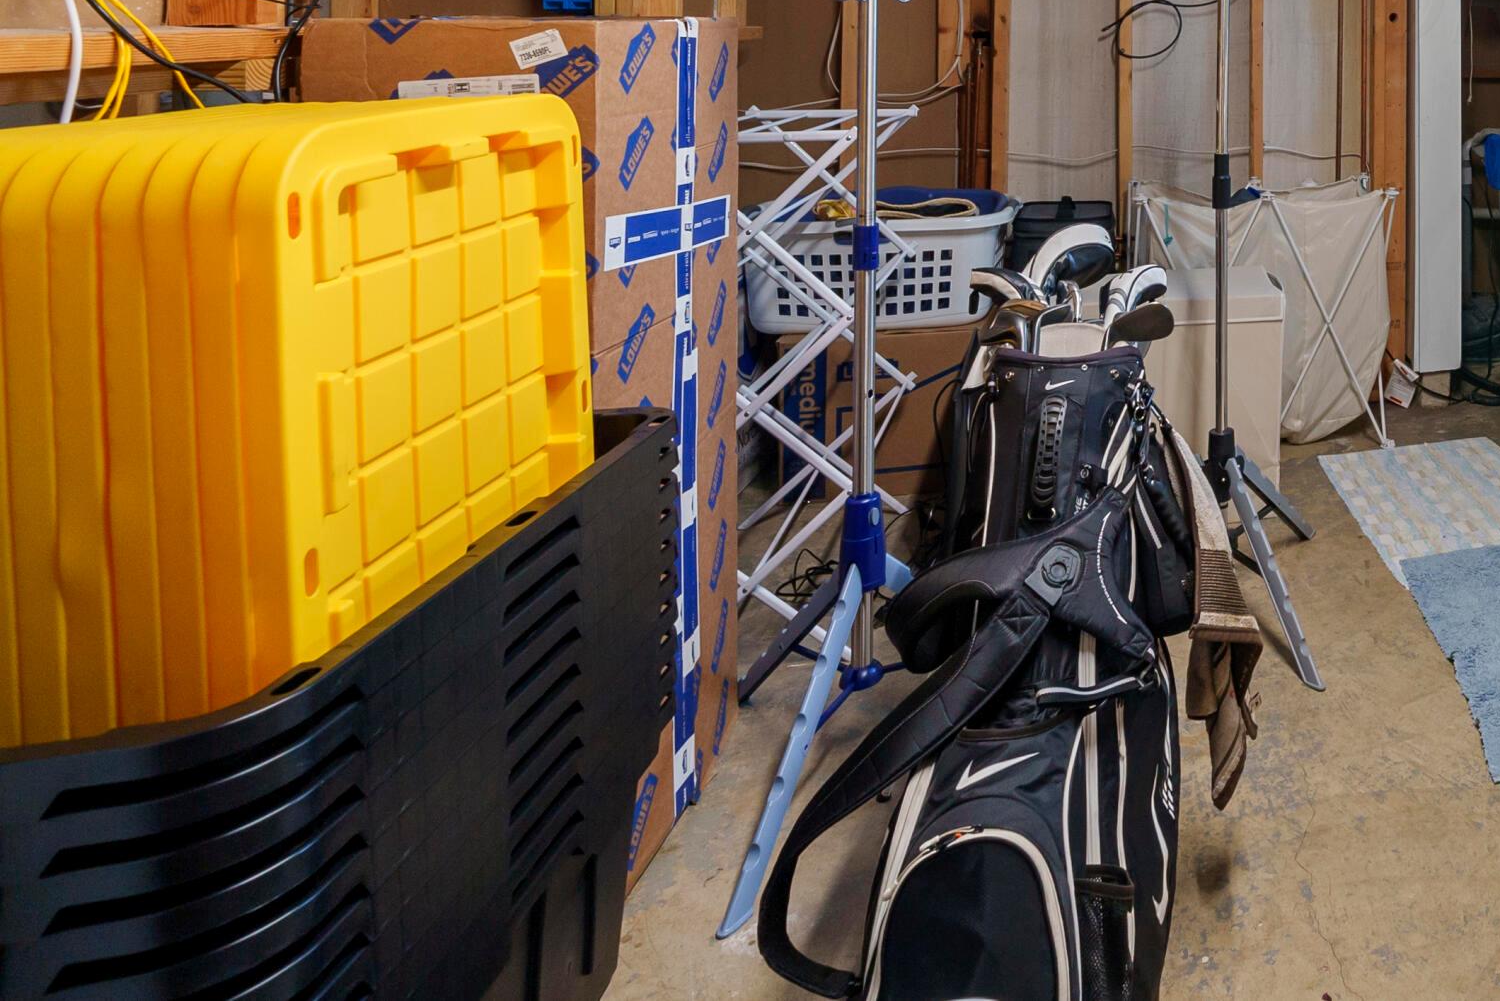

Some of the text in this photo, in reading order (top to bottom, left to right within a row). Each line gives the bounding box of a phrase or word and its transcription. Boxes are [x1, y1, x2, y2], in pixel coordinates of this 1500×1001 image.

[622, 31, 653, 83] LOWE'S
[621, 124, 651, 181] LOWE'S
[621, 313, 651, 373] LOWE'S
[798, 360, 822, 435] mediu
